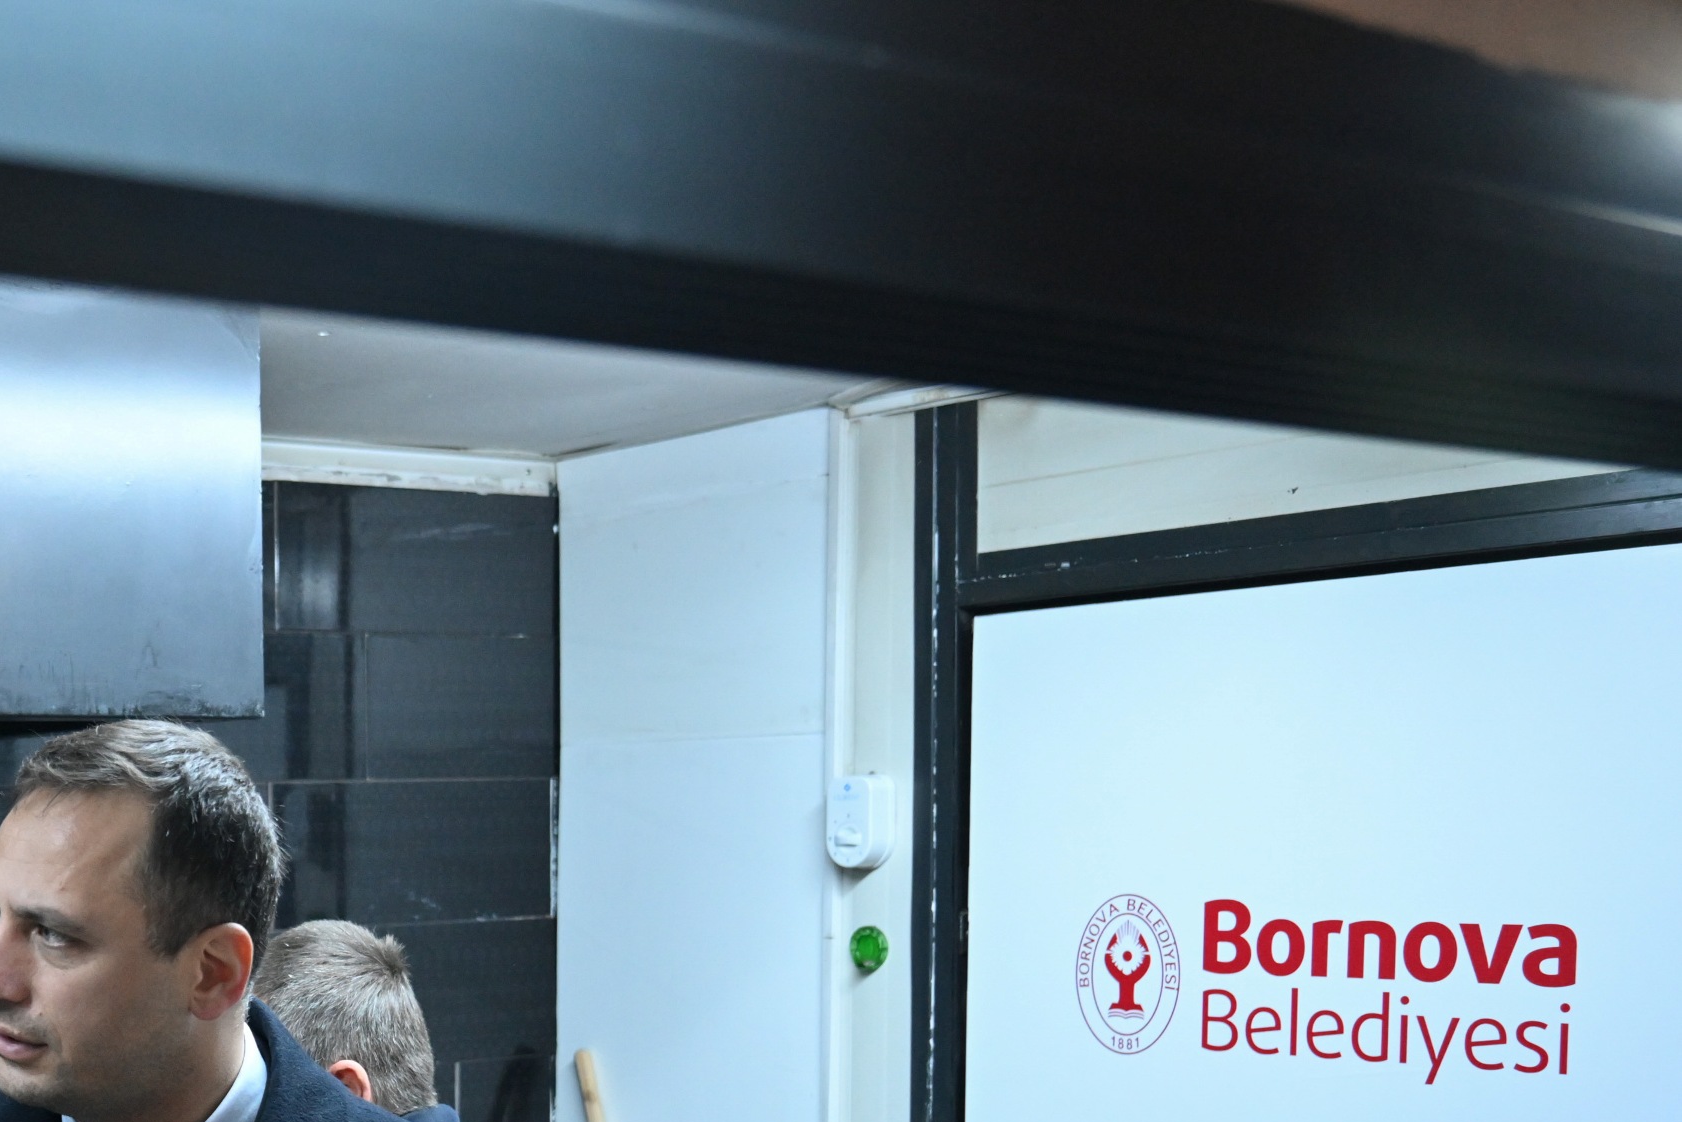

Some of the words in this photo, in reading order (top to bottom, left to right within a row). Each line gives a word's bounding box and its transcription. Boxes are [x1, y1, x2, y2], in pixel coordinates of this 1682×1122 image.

[1078, 902, 1120, 989] BORNOVA
[1126, 898, 1180, 992] BELEDİYESİ
[1203, 899, 1578, 988] Bornova
[1111, 1035, 1140, 1051] 1881
[1201, 987, 1572, 1085] Belediyesi
